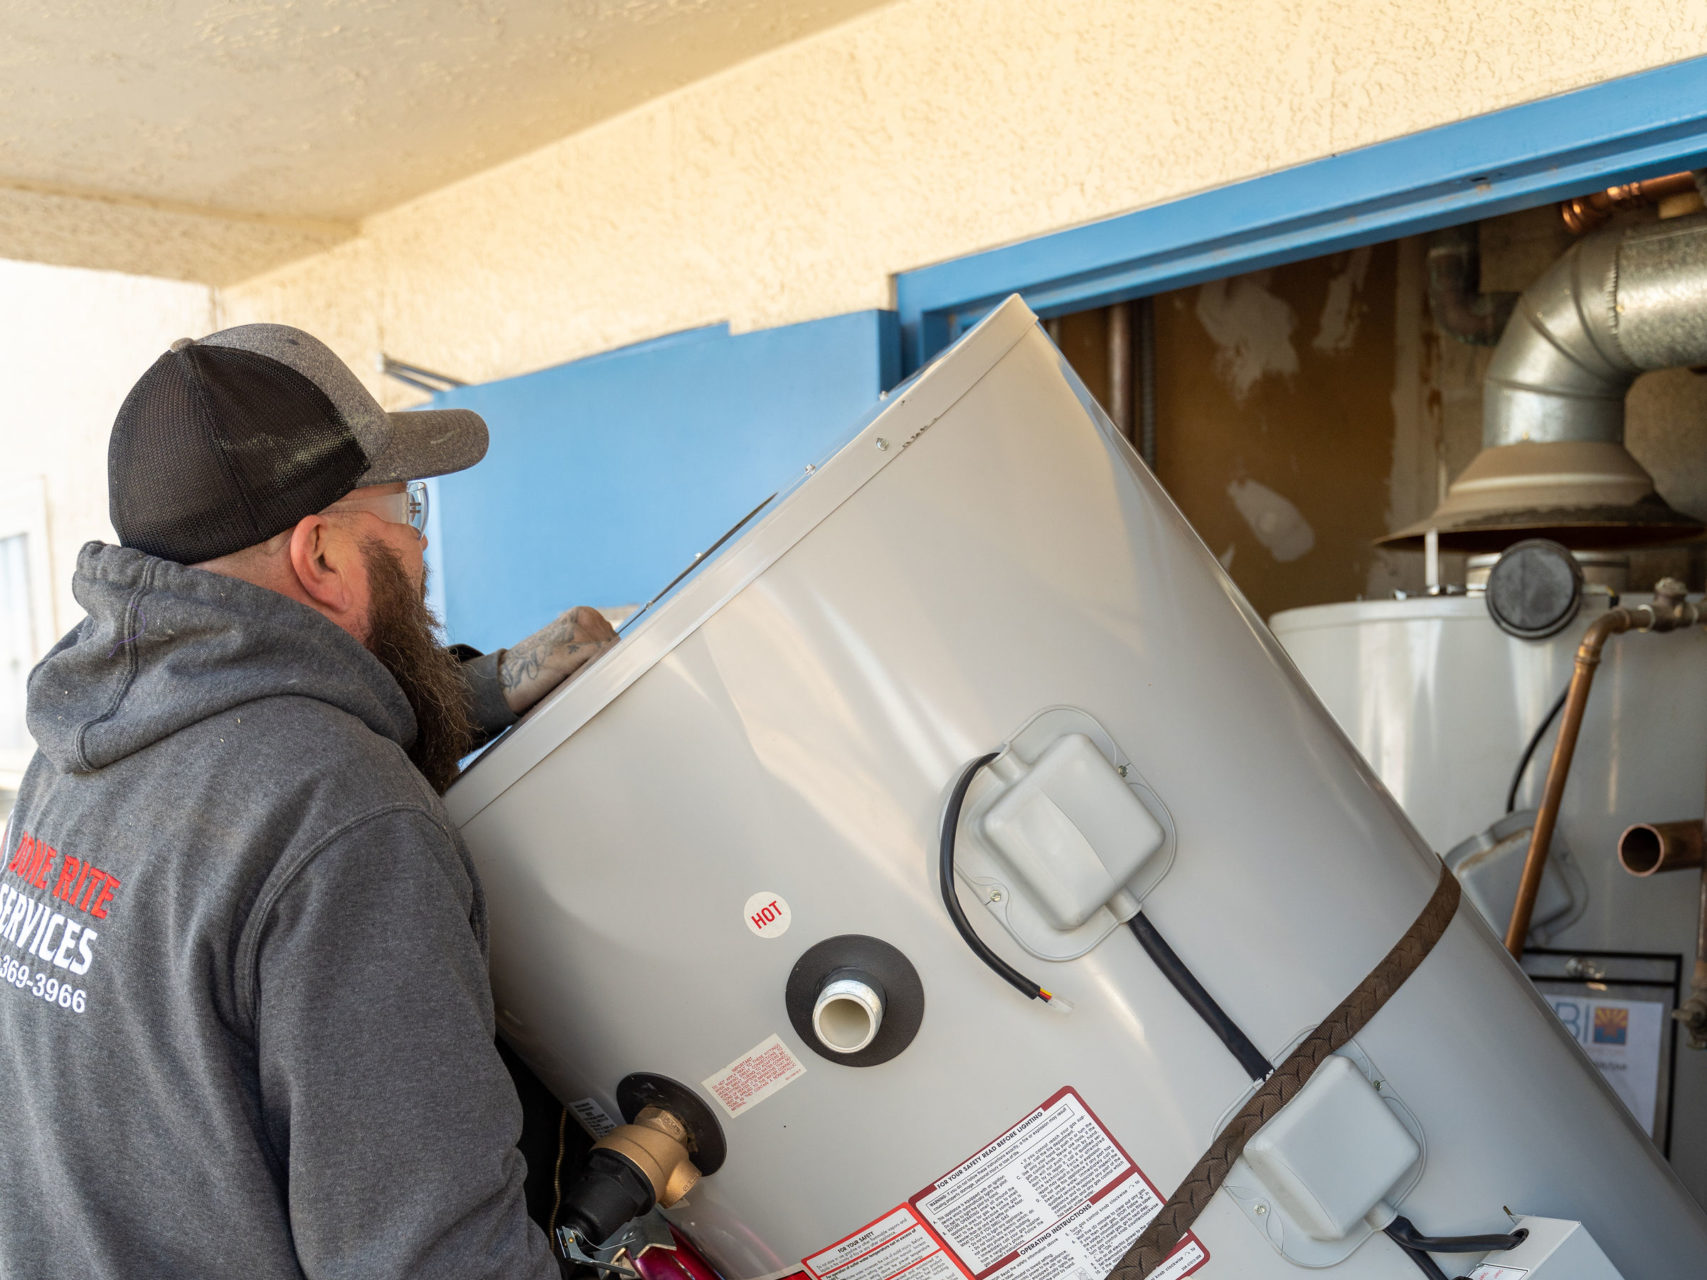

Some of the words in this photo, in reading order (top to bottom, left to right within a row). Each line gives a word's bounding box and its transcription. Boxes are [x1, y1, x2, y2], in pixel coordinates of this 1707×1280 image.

[52, 854, 121, 919] RITE
[751, 900, 782, 929] HOT
[0, 883, 98, 975] SERVICES
[0, 954, 86, 1013] 369-3966
[937, 1179, 949, 1190] FOR
[947, 1168, 964, 1183] YOUR
[963, 1155, 982, 1172] SAFETY
[981, 1145, 997, 1158] READ
[996, 1130, 1017, 1147] BEFORE
[1016, 1111, 1044, 1133] LIGHTING
[859, 1231, 874, 1242] SAFETY
[1020, 1232, 1052, 1256] OPERATING
[1051, 1203, 1092, 1234] INSTRUCTIONS
